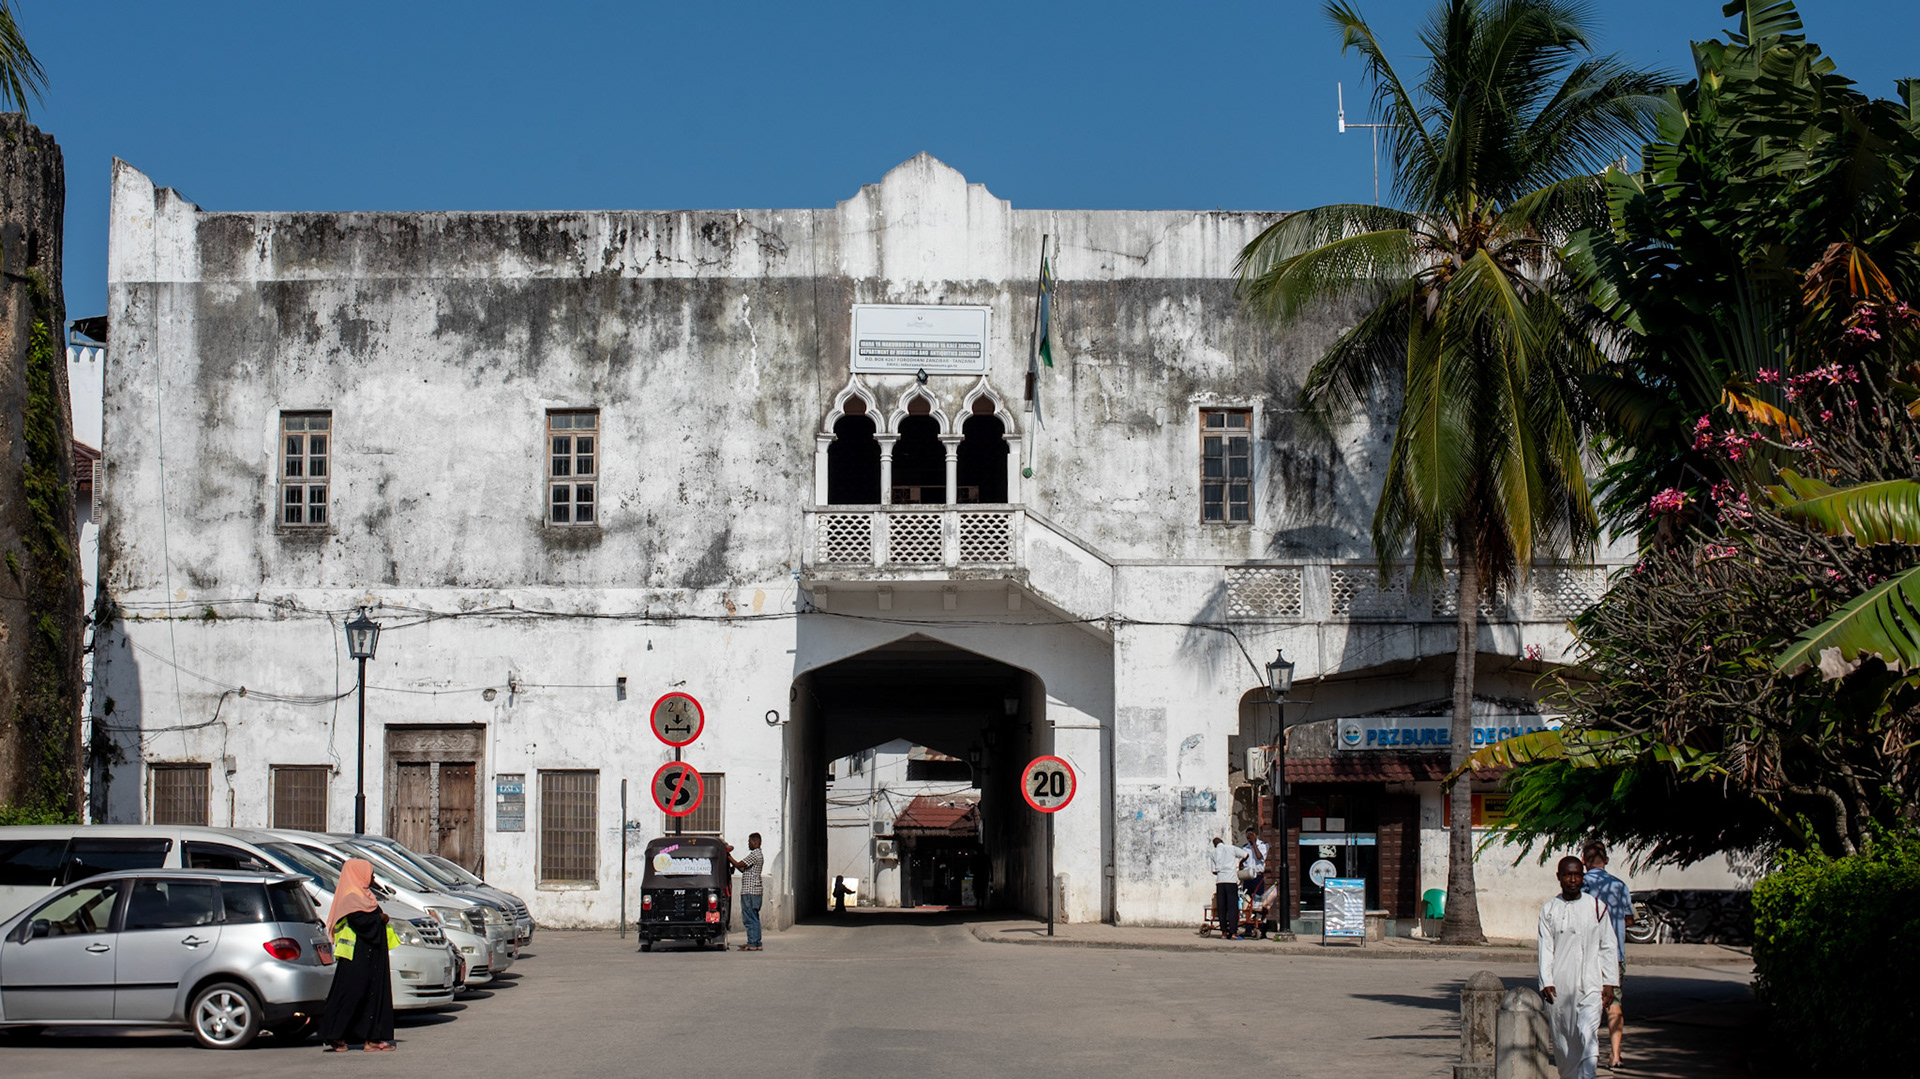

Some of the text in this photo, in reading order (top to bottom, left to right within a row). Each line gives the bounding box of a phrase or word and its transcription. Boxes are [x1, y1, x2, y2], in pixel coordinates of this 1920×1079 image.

[668, 702, 675, 713] 2
[1366, 729, 1400, 746] PBZ
[1401, 727, 1471, 746] BURE
[1473, 727, 1497, 745] DE
[664, 772, 690, 806] S
[1033, 771, 1065, 797] 20
